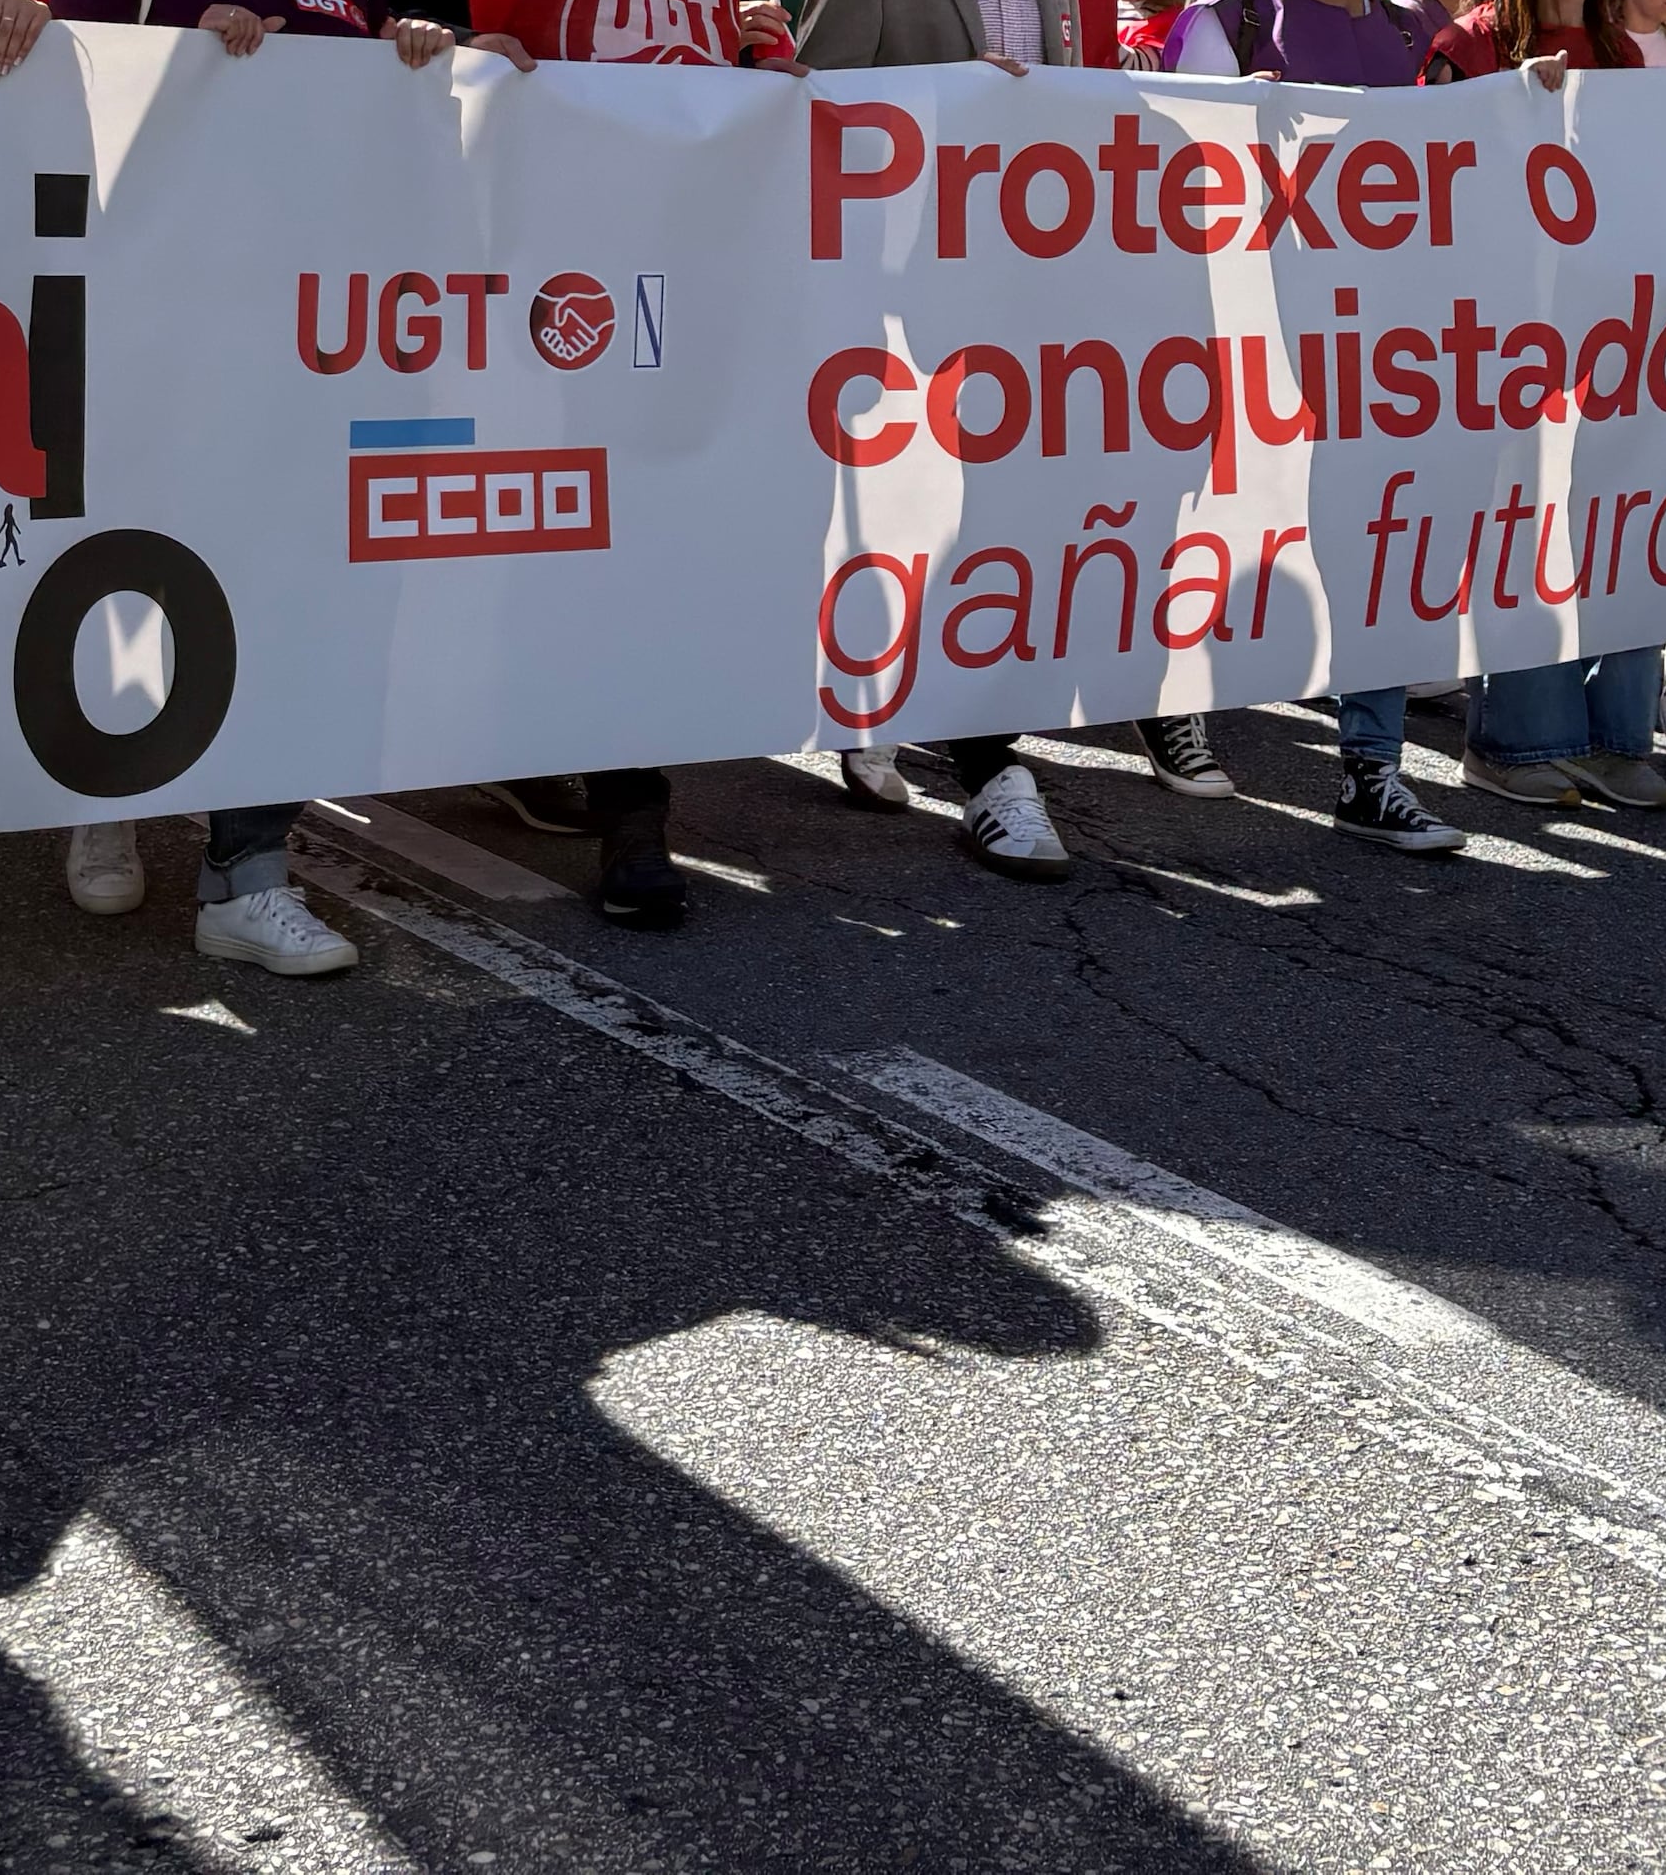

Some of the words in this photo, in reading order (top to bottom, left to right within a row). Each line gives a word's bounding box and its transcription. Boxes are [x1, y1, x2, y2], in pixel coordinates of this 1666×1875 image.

[811, 100, 1477, 261] Protexer
[1526, 142, 1597, 246] o
[297, 271, 510, 375] UGT
[367, 470, 592, 539] CCOO
[818, 501, 1307, 730] gañar
